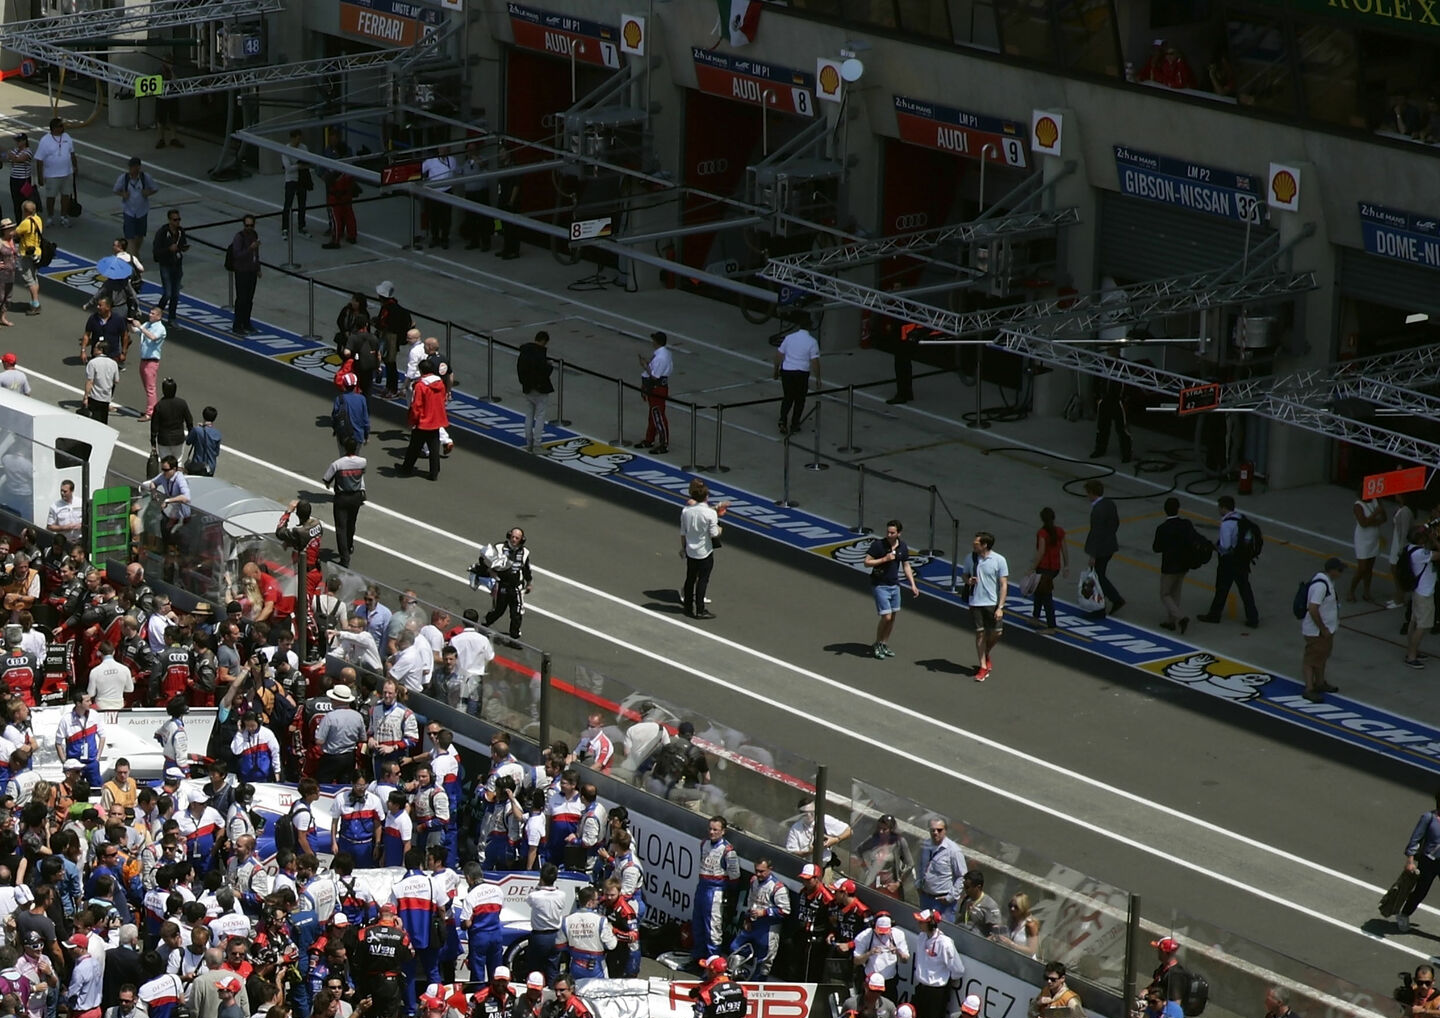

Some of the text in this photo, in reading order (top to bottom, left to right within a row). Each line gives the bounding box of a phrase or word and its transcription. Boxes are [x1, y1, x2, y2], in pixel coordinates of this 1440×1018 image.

[357, 11, 405, 42] FERRARI
[562, 18, 581, 32] LM P1
[544, 31, 573, 56] AUDI
[605, 45, 612, 65] 7
[752, 63, 770, 77] LM P1
[139, 77, 157, 94] 66
[732, 77, 761, 102] AUDI
[798, 92, 807, 113] 8
[959, 112, 978, 128] LM P1
[937, 126, 969, 153] AUDI
[1009, 141, 1018, 163] 9
[1187, 165, 1210, 182] LM P2
[1125, 170, 1229, 216] GIBSON-NISSAN
[572, 223, 582, 238] 8
[104, 711, 119, 725] HY
[279, 793, 294, 807] HY
[476, 888, 497, 897] DENSO
[662, 880, 691, 913] App
[222, 920, 245, 928] DENSO
